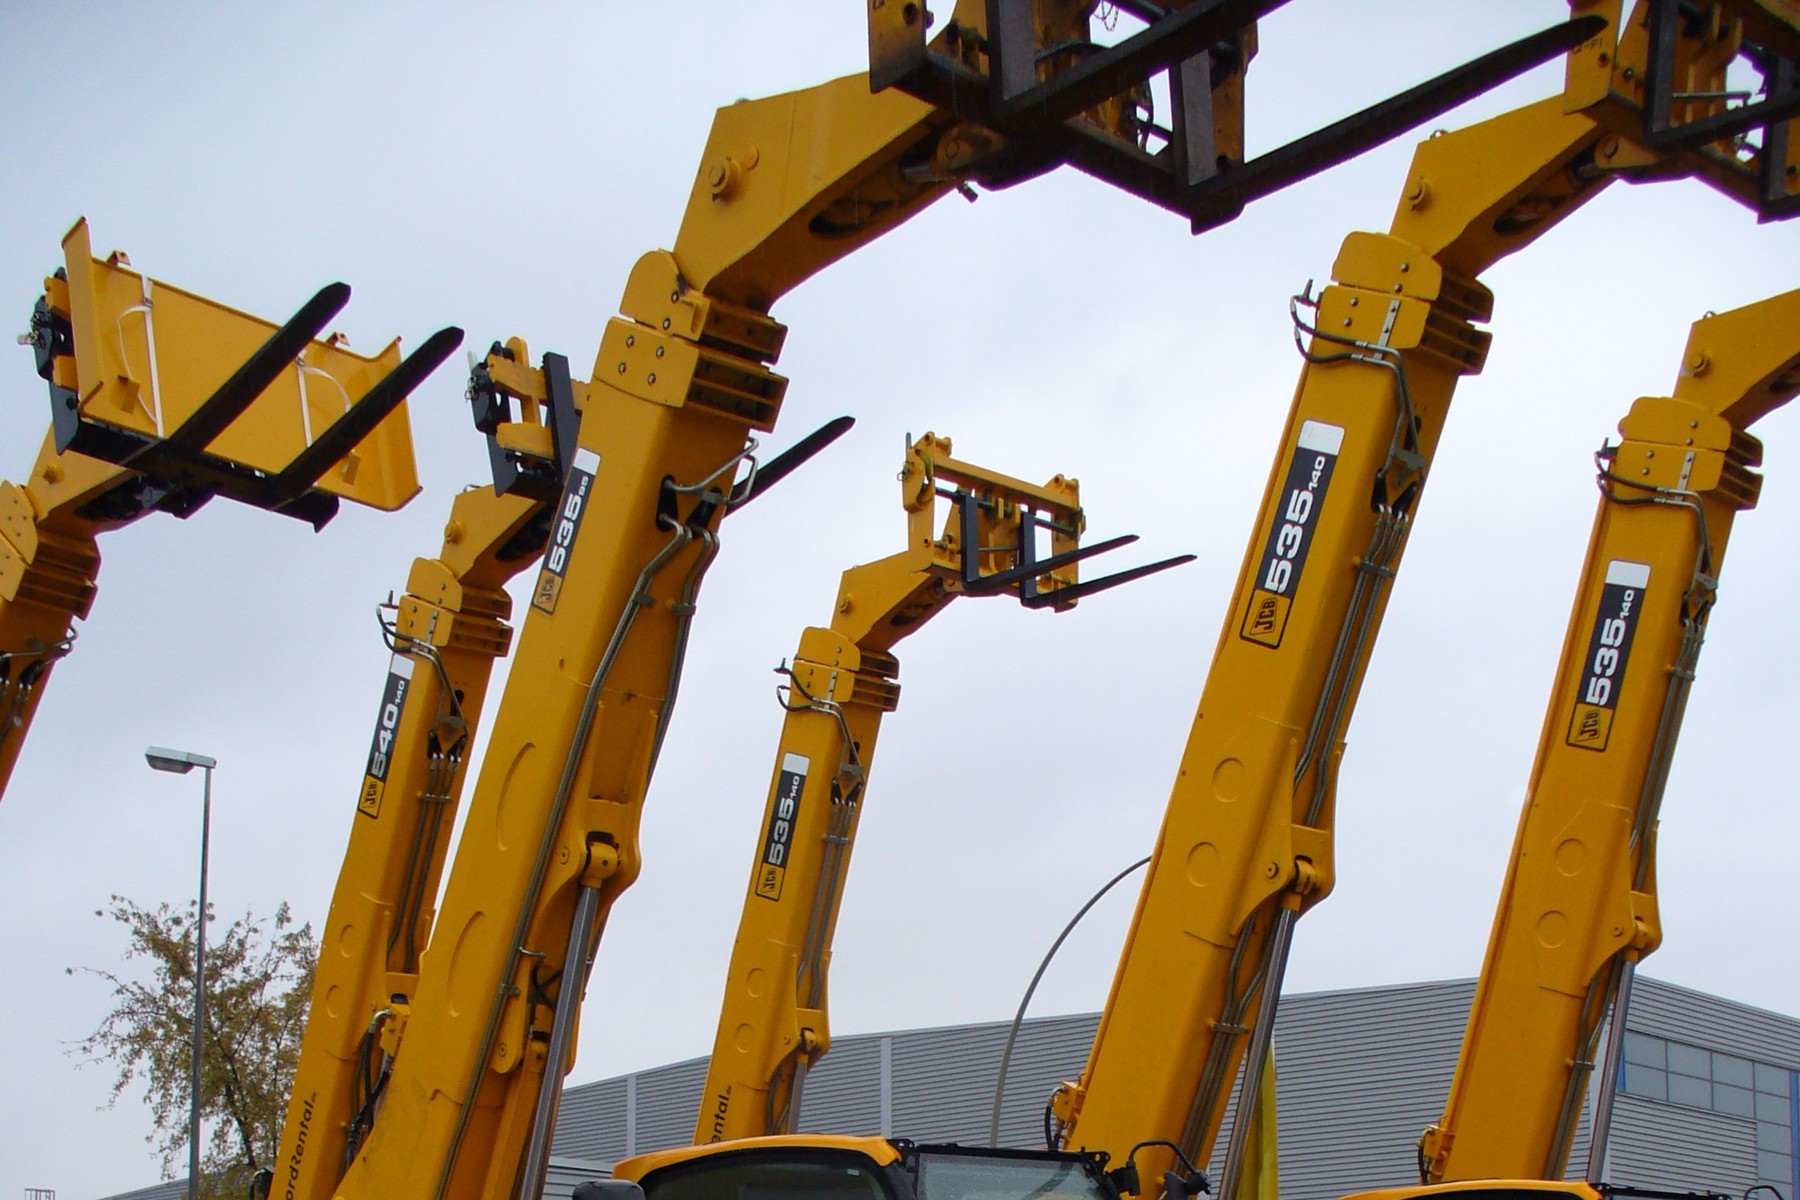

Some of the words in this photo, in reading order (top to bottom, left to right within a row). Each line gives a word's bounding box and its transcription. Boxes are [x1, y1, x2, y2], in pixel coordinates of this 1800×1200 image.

[1308, 455, 1326, 491] 140
[540, 577, 555, 601] JCB
[548, 493, 583, 573] 535
[1264, 488, 1314, 594] 535
[1254, 600, 1276, 631] JCB
[1619, 589, 1635, 619] 140
[1585, 618, 1627, 707] 535
[395, 680, 405, 705] 140
[1579, 709, 1599, 738] JCB
[371, 703, 399, 778] 540
[365, 781, 378, 806] JCB
[790, 775, 800, 799] 140
[768, 797, 795, 866] 535
[763, 868, 776, 890] JCB
